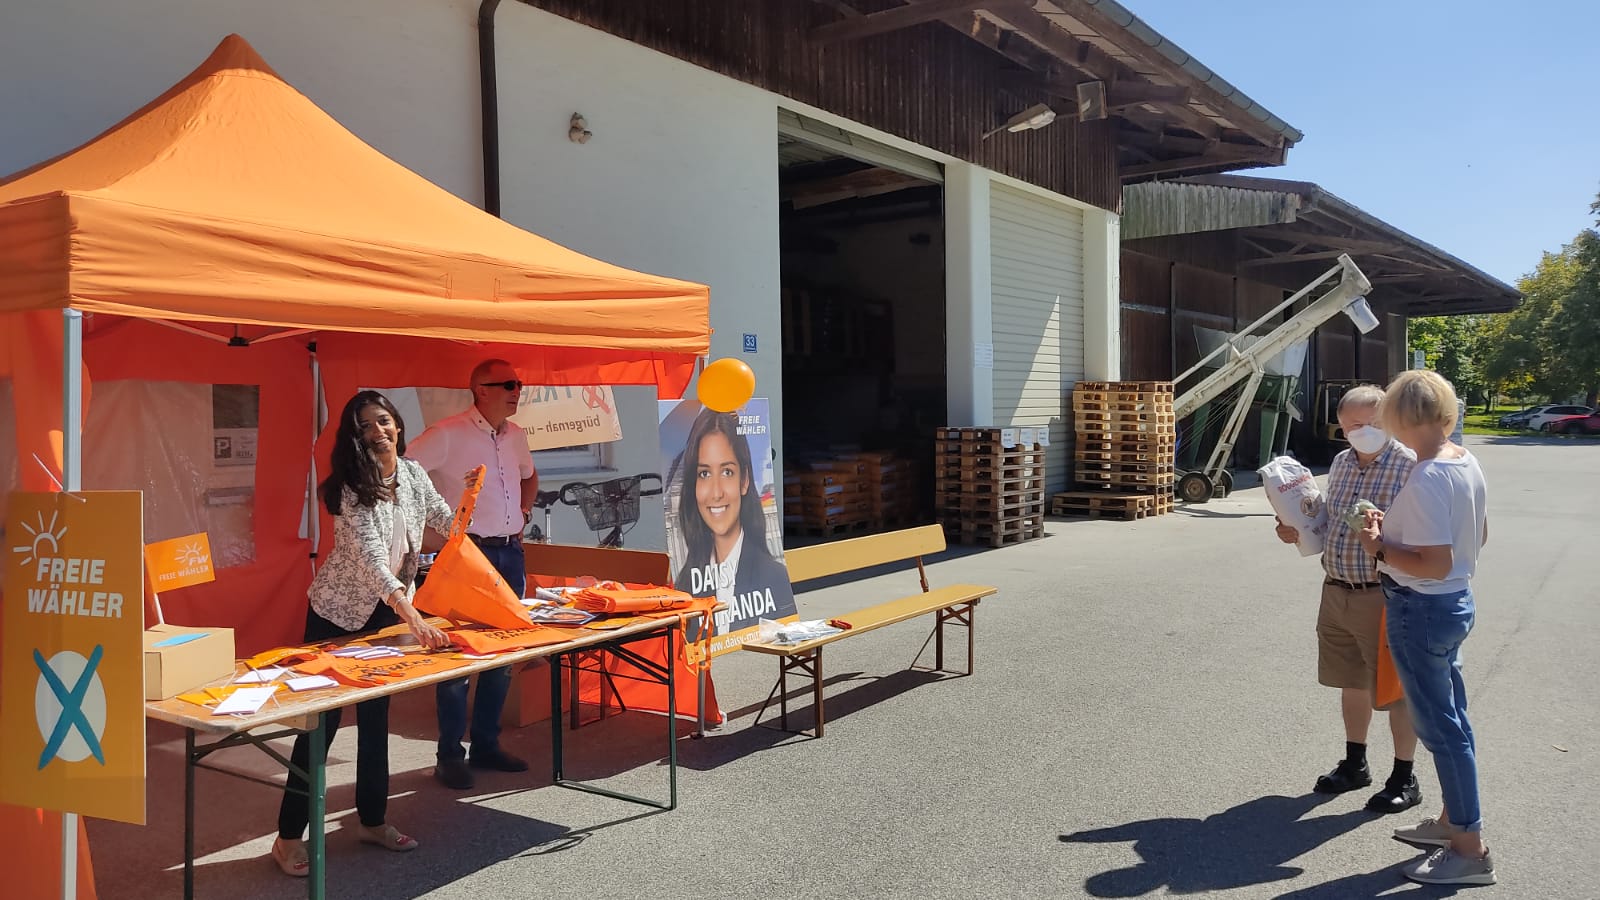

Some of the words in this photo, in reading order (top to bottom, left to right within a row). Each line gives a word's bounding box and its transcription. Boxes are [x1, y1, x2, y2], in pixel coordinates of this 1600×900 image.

[745, 335, 755, 346] 33
[738, 415, 760, 425] FREIE
[736, 425, 767, 436] WÄHLER
[189, 554, 208, 567] FW
[36, 557, 106, 585] FREIE
[159, 571, 177, 582] FREIE
[178, 565, 209, 577] WÄHLER
[690, 564, 736, 595] DAISY
[28, 583, 124, 618] WÄHLER
